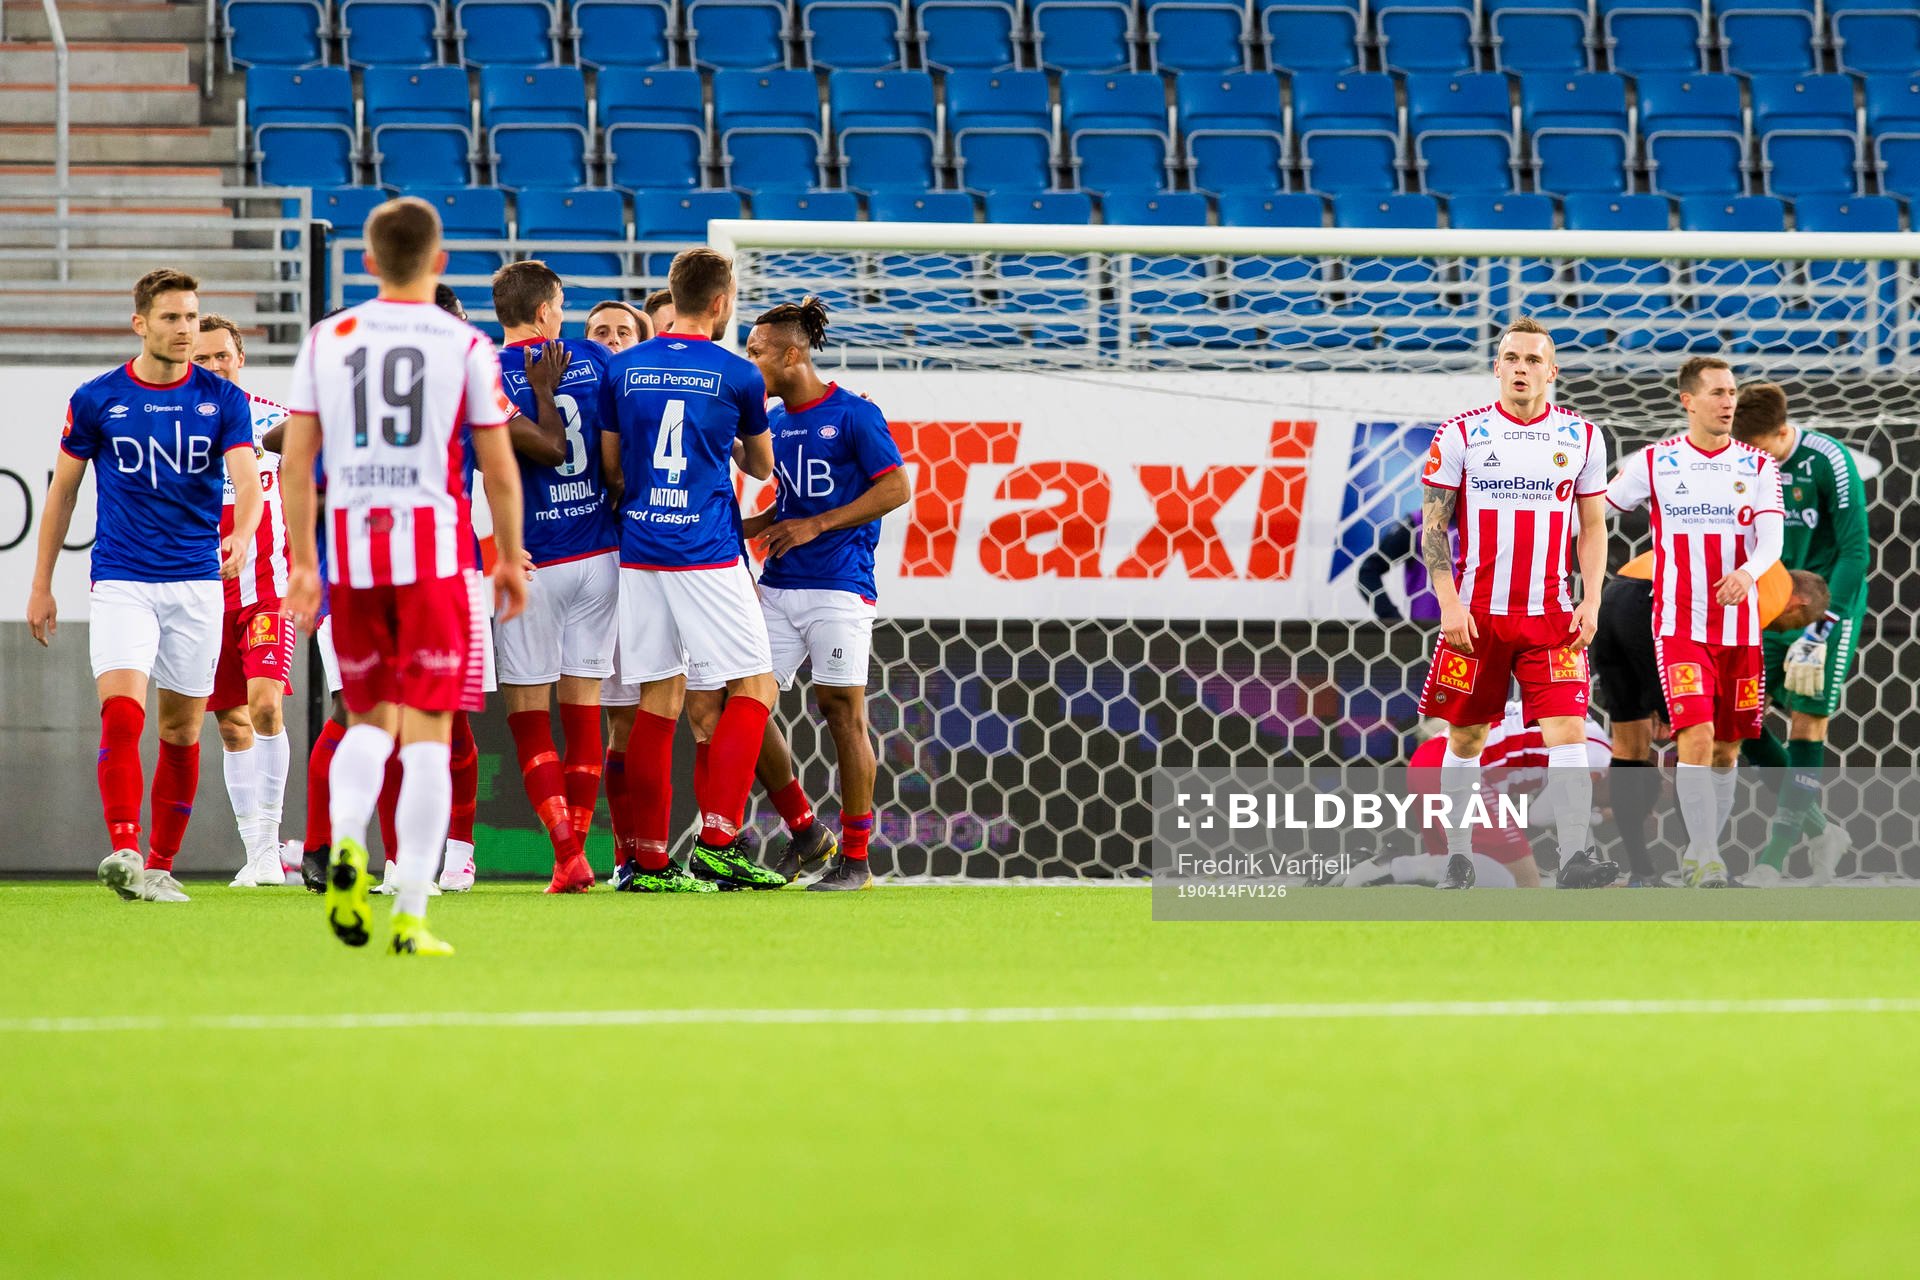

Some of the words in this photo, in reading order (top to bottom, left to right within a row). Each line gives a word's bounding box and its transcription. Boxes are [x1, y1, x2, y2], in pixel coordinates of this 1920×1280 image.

[630, 372, 659, 385] Grata
[663, 373, 714, 389] Personal
[343, 346, 425, 448] 19
[653, 399, 687, 484] 4
[1467, 439, 1492, 449] telenor
[1557, 440, 1581, 449] telenor
[112, 420, 211, 490] DNB
[775, 444, 835, 512] NB
[1471, 476, 1554, 491] SpareBank
[649, 487, 689, 508] NATION
[887, 421, 1318, 581] Taxi
[535, 508, 561, 521] mot
[626, 510, 648, 521] mot
[1664, 503, 1736, 516] SpareBank
[831, 647, 843, 659] 40
[1555, 669, 1584, 678] EXTRA
[1441, 674, 1471, 691] EXTRA
